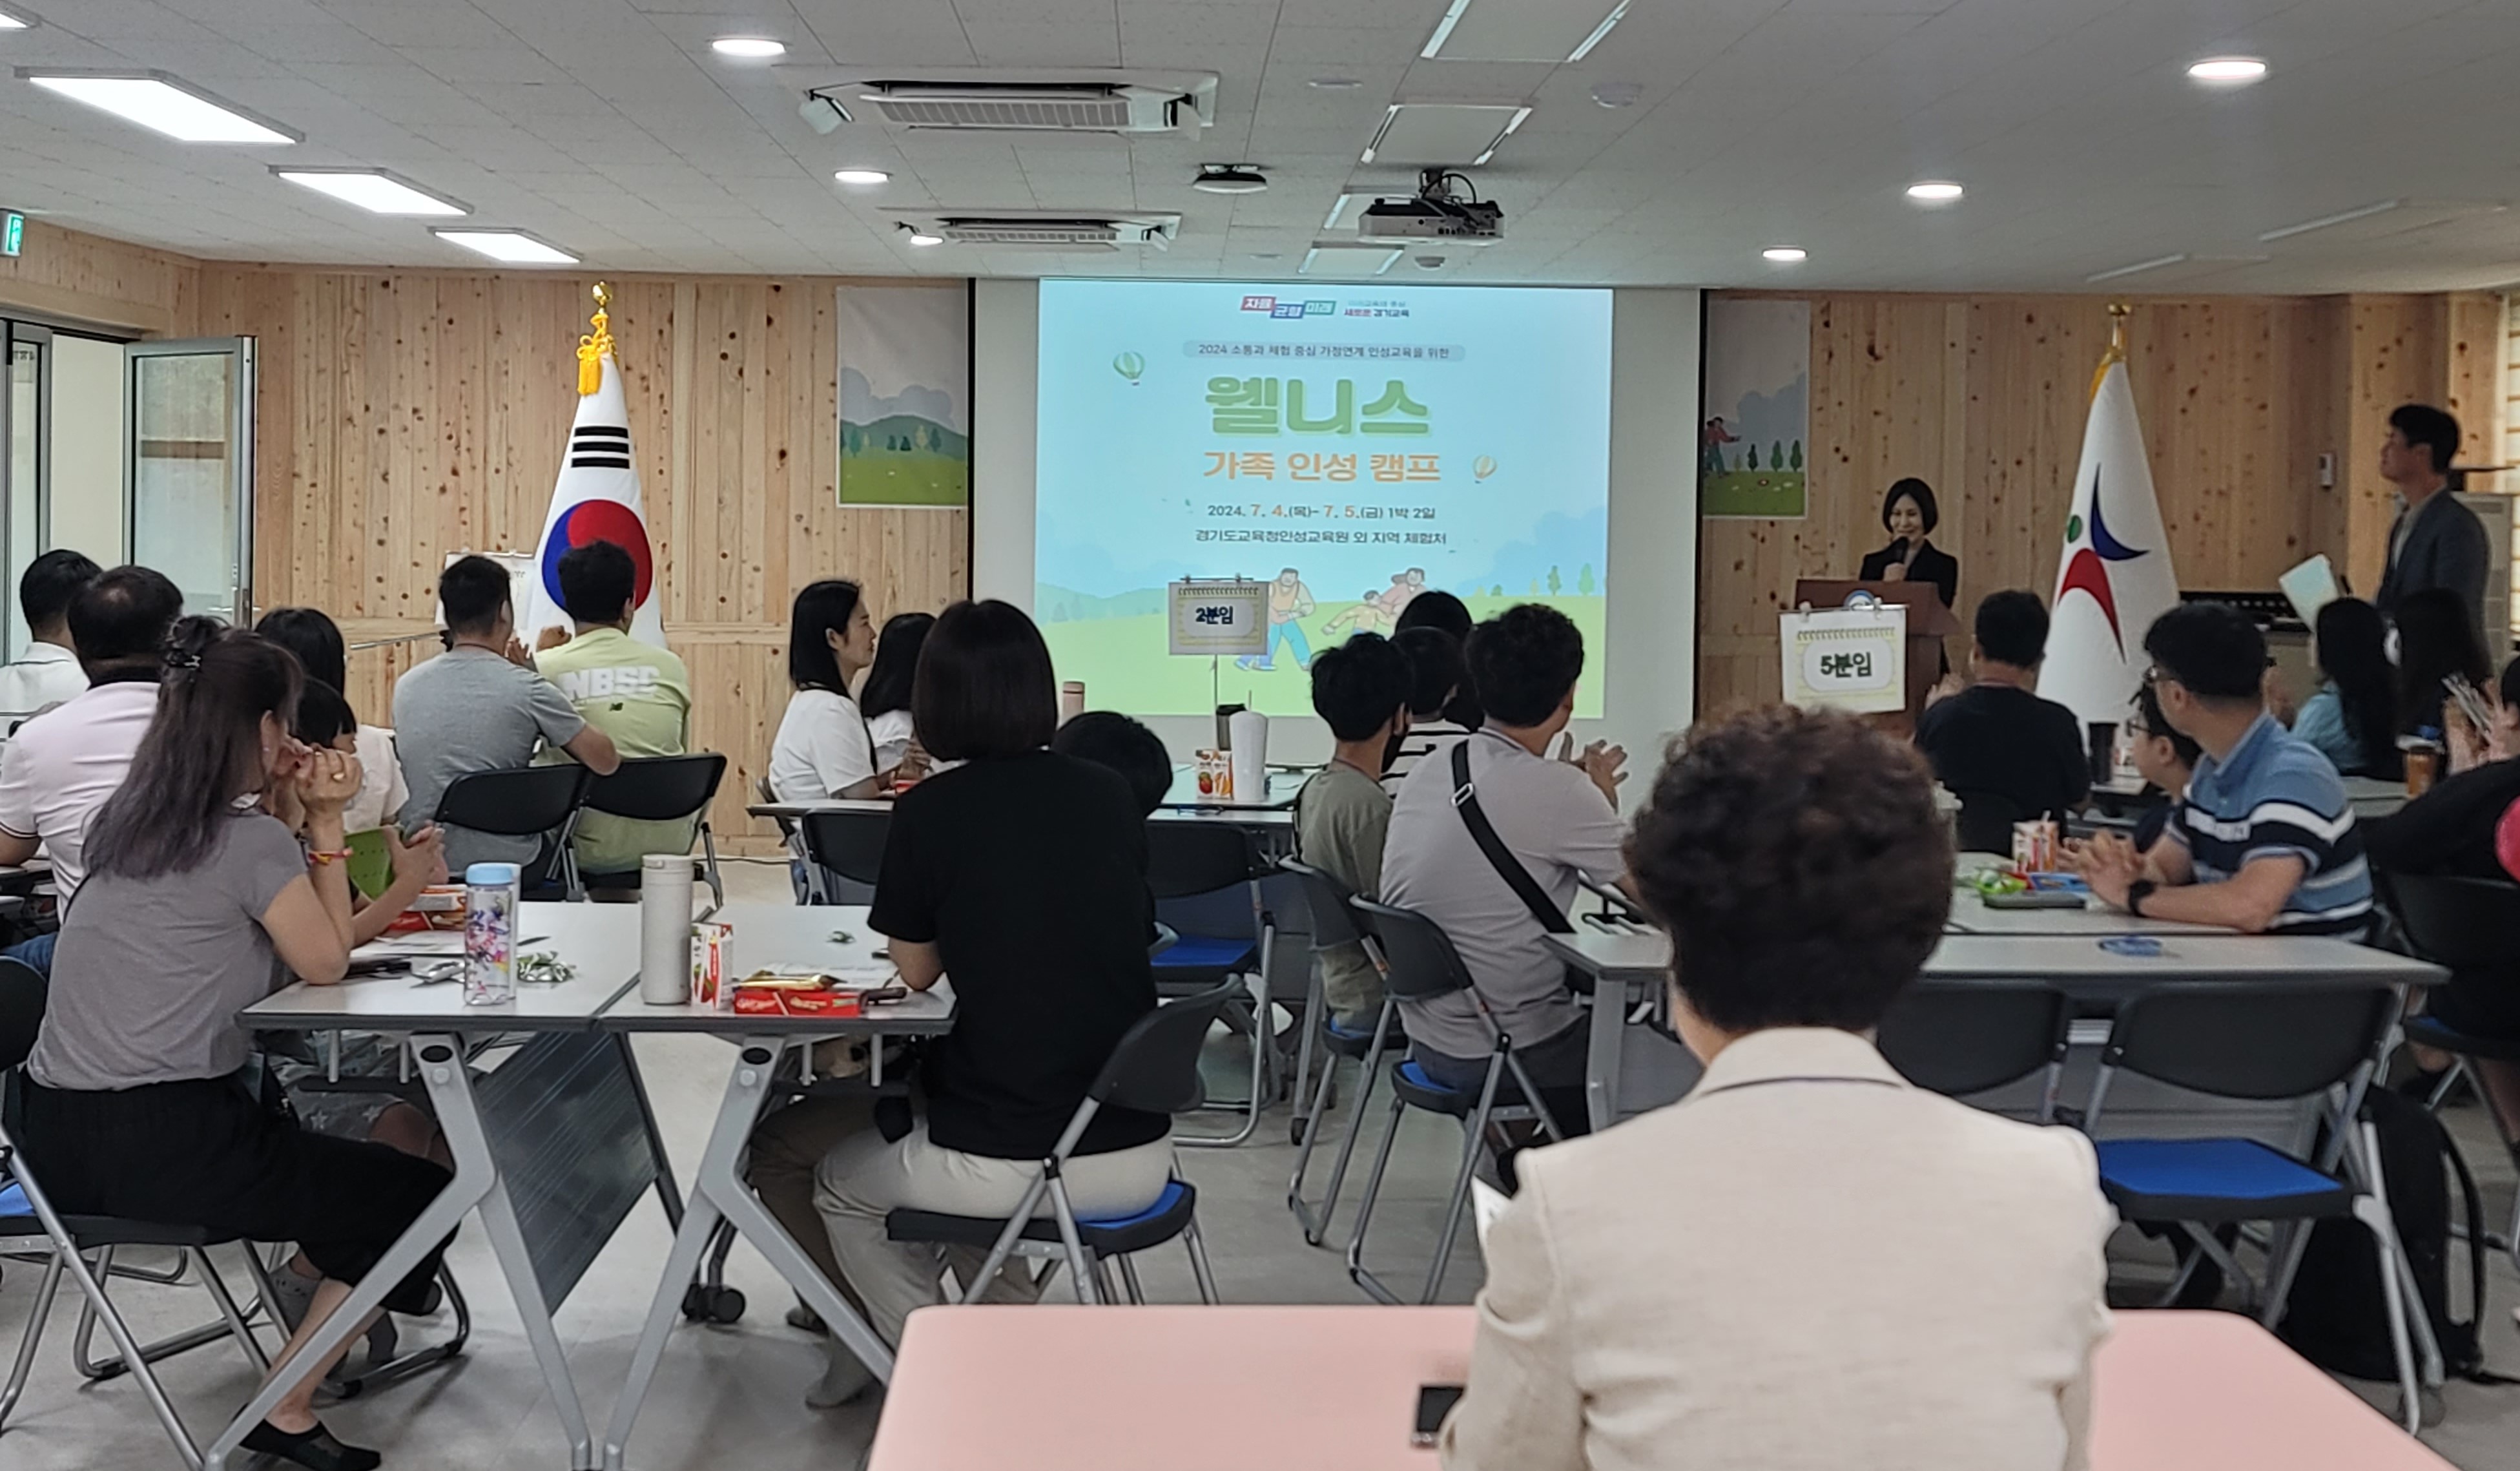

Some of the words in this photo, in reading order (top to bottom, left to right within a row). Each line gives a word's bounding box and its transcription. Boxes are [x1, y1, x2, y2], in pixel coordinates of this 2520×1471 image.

[1199, 344, 1227, 355] 2024
[1232, 344, 1264, 355] 소통과
[1269, 345, 1290, 356] 체험
[1295, 345, 1316, 357] 중심
[1320, 346, 1365, 357] 가정연계
[1368, 346, 1423, 358] 인성교육을
[1428, 347, 1449, 359] 위한
[1204, 377, 1430, 435] 웰니스
[1203, 452, 1275, 481] 가족
[1287, 453, 1358, 482] 인성
[1370, 454, 1441, 483] 캠프
[1207, 505, 1246, 517] 2024.
[1251, 504, 1266, 517] 7.
[1324, 505, 1339, 519] 7.
[1388, 507, 1409, 519] 1박
[1412, 507, 1436, 519] 2일
[1195, 529, 1349, 544] 경기도교육청인성교육원
[1353, 531, 1367, 544] 외
[1371, 532, 1400, 545] 지역
[1404, 532, 1447, 545] 체험처
[1195, 605, 1234, 625] 2분임
[1820, 651, 1872, 678] 5분임
